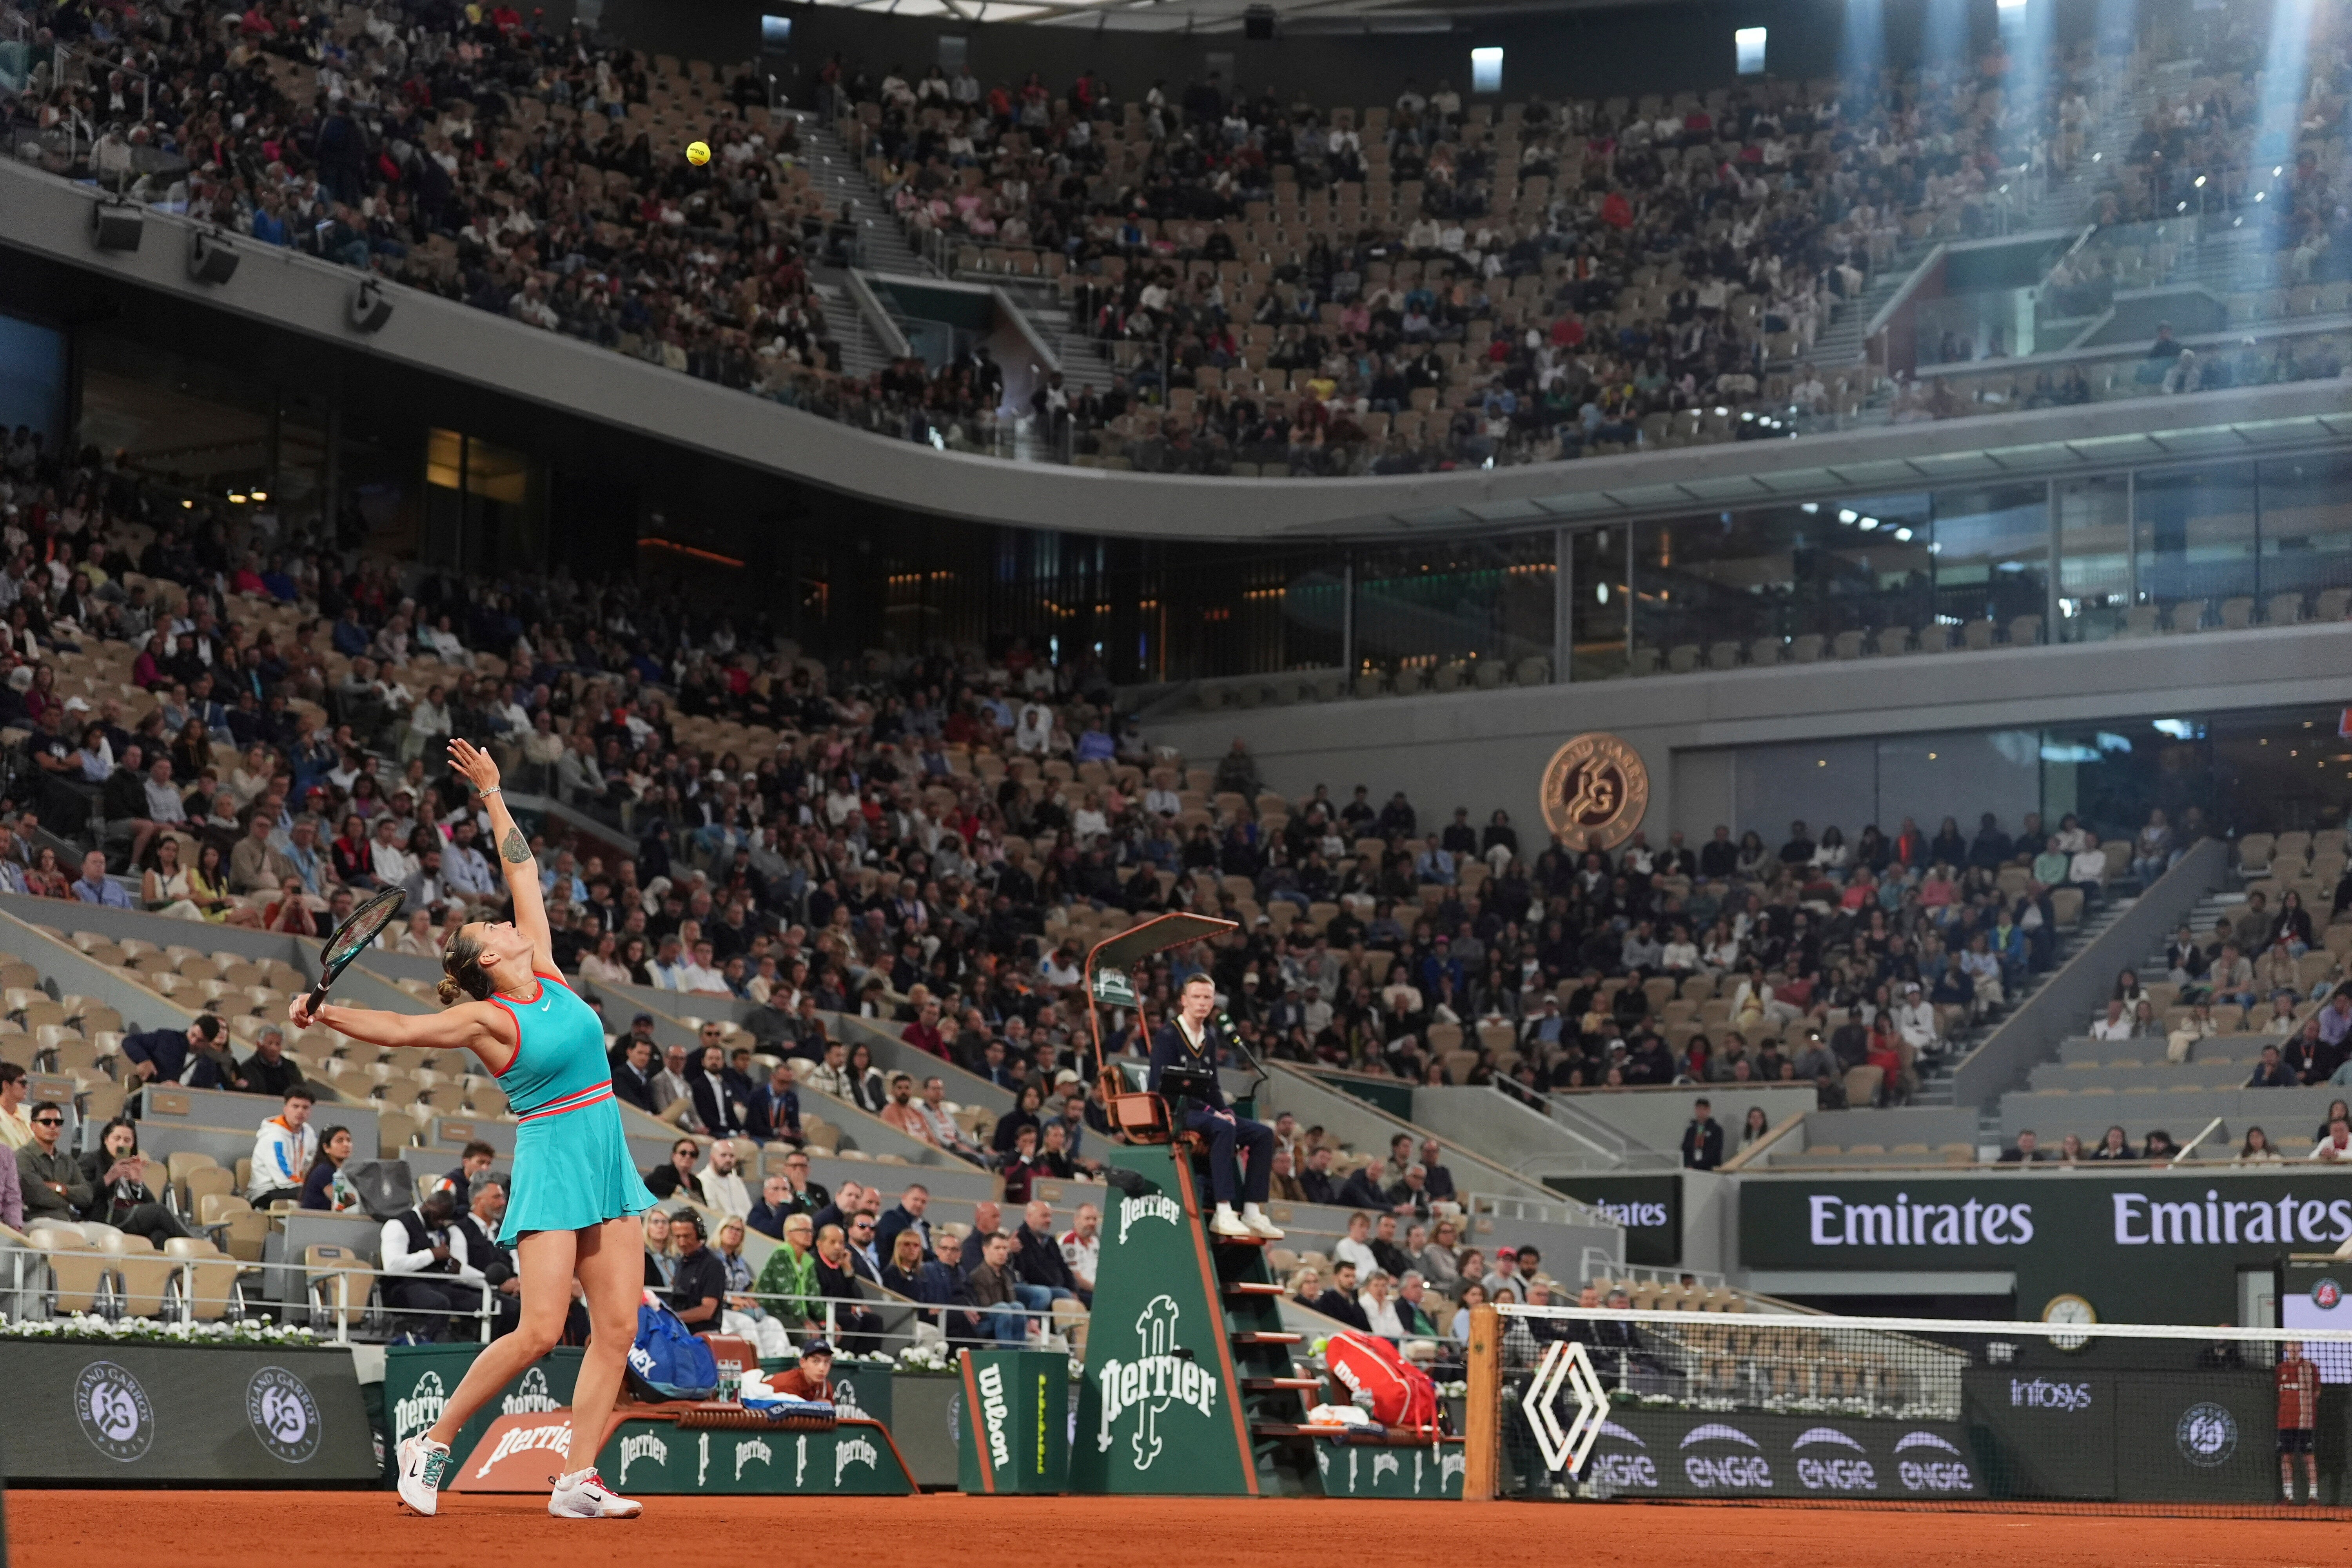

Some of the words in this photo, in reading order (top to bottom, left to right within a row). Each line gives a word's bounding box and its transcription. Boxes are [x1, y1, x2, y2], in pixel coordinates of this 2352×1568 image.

[1809, 1192, 2034, 1245] Emirates
[2112, 1189, 2352, 1245] Emirates
[79, 1367, 105, 1421] ROLAND
[108, 1368, 151, 1422] GARROS
[250, 1372, 274, 1424] ROLAND
[276, 1373, 317, 1425] GARROS
[978, 1363, 1009, 1471] Wilson
[2010, 1377, 2092, 1412] Infosys
